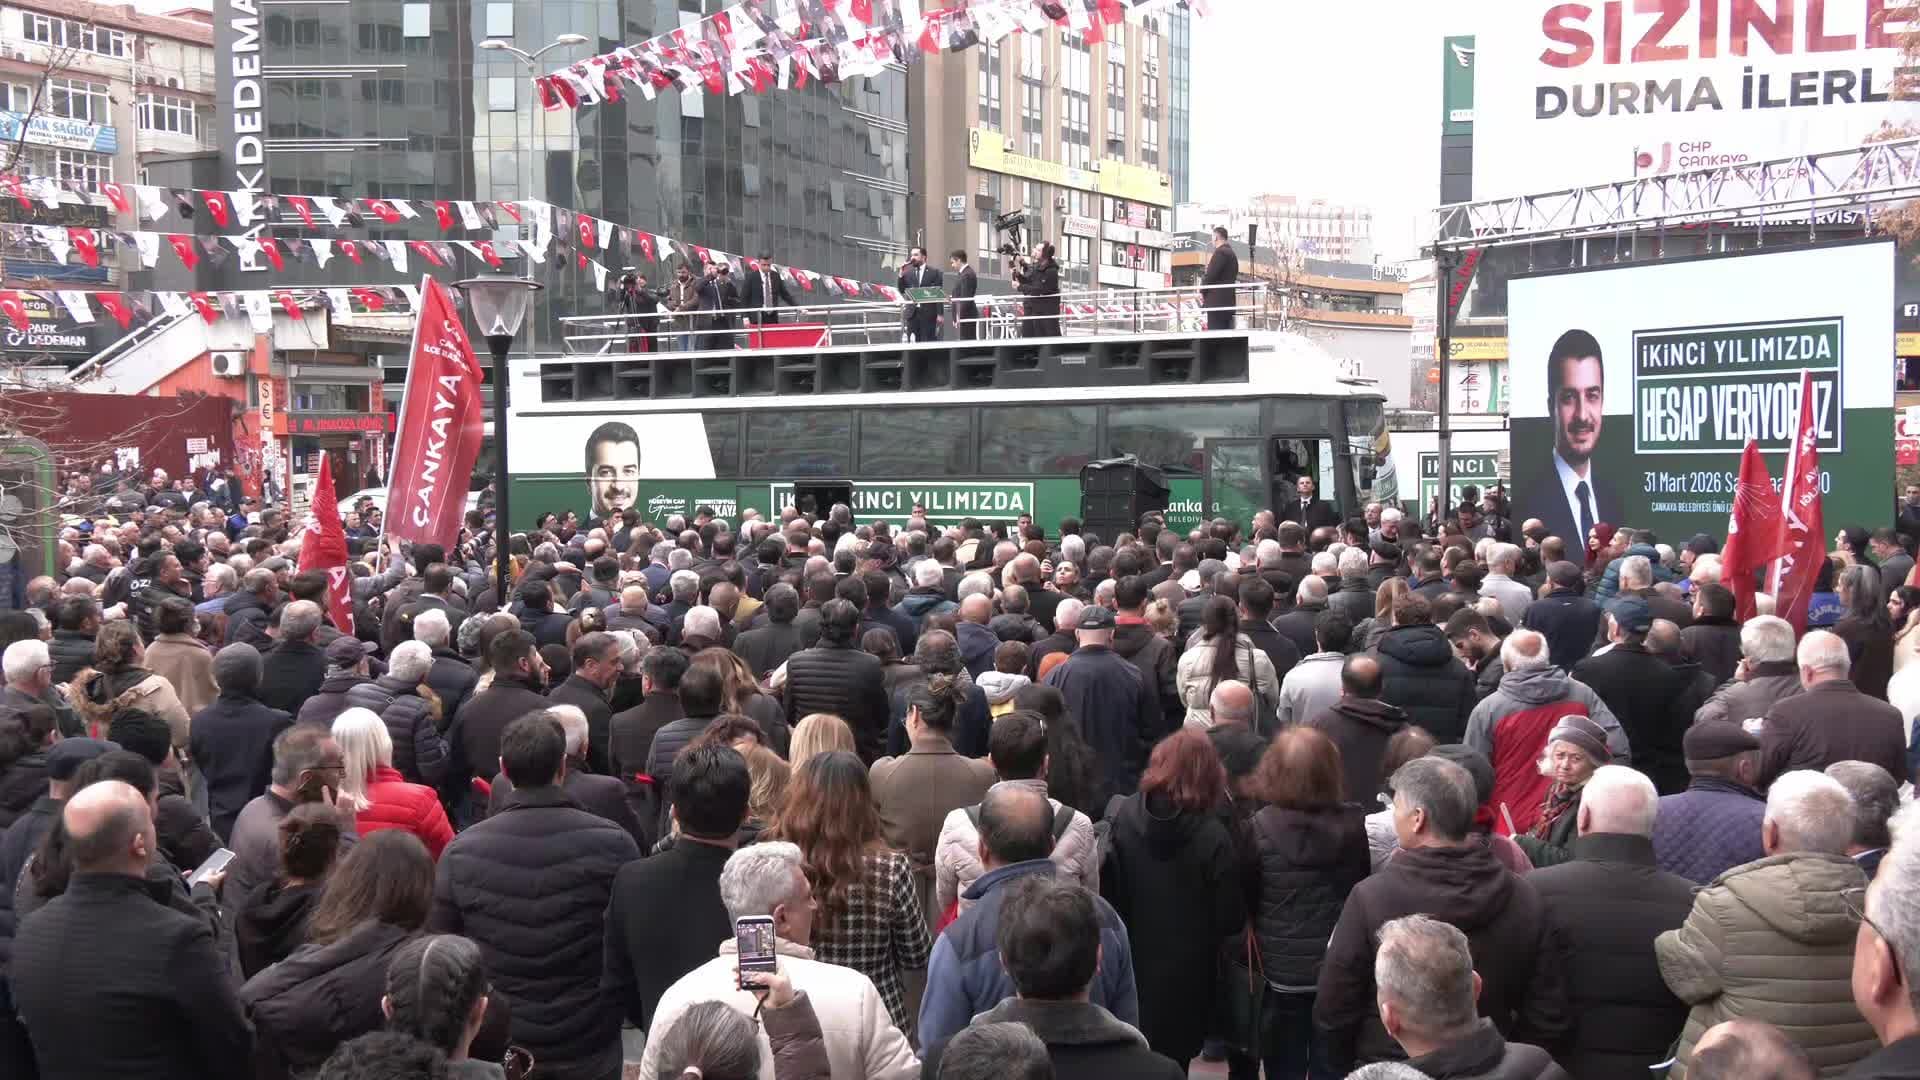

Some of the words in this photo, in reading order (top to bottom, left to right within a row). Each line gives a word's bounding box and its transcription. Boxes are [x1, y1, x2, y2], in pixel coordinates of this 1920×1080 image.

[1535, 75, 1723, 119] DURMA
[1679, 141, 1712, 153] CHP
[28, 323, 57, 334] PARK
[28, 334, 87, 346] DEDEMAN
[1642, 341, 1706, 368] İKİNCİ
[1713, 334, 1832, 364] YILIMIZDA
[1641, 386, 1708, 442] HESAP
[412, 375, 462, 528] ÇANKAYA
[1643, 472, 1656, 493] 31
[1659, 472, 1687, 493] Mart
[1690, 472, 1721, 493] 2026
[909, 490, 1025, 511] YILIMIZDA
[1678, 500, 1712, 513] BELEDİYESİ
